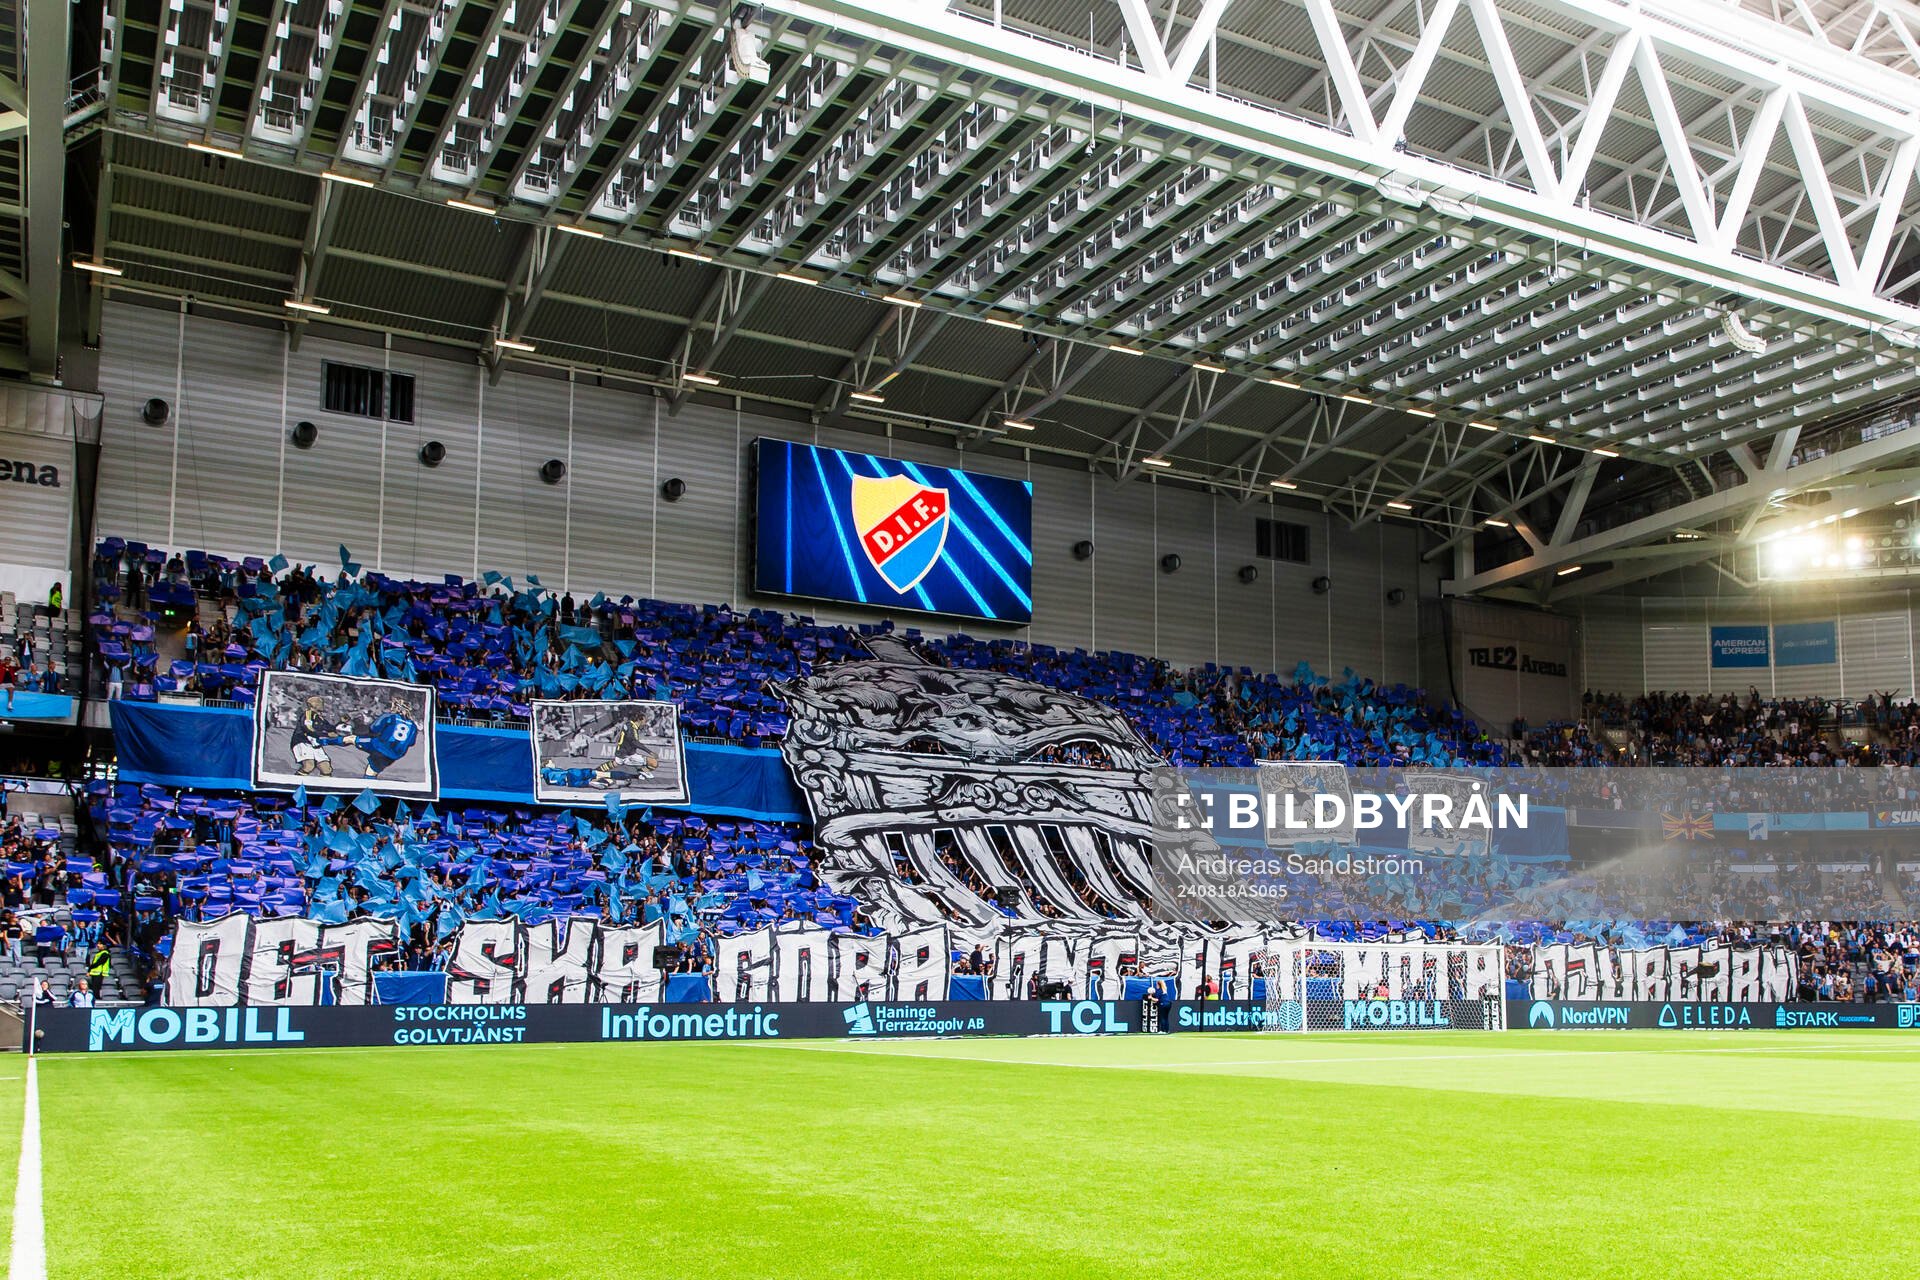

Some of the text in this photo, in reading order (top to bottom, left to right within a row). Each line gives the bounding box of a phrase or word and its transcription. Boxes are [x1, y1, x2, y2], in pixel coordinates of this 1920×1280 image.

[1468, 646, 1568, 677] TELE2 Arena
[162, 909, 402, 1006] DET
[446, 915, 667, 1004] SKA
[394, 1006, 527, 1021] STOCKHOLMS
[602, 1006, 779, 1038] Infometric
[876, 1005, 936, 1020] Haninge
[1041, 1001, 1128, 1033] TCL
[1178, 1005, 1278, 1027] Sundström
[1344, 1000, 1449, 1030] MOBILL
[1562, 1007, 1629, 1024] NordVPN
[1684, 1006, 1751, 1025] ELEDA
[1786, 1012, 1838, 1026] STARK
[89, 1008, 305, 1051] MOBILL
[393, 1021, 526, 1044] GOLVTJÄNST
[877, 1017, 985, 1034] Terrazzogolv AB
